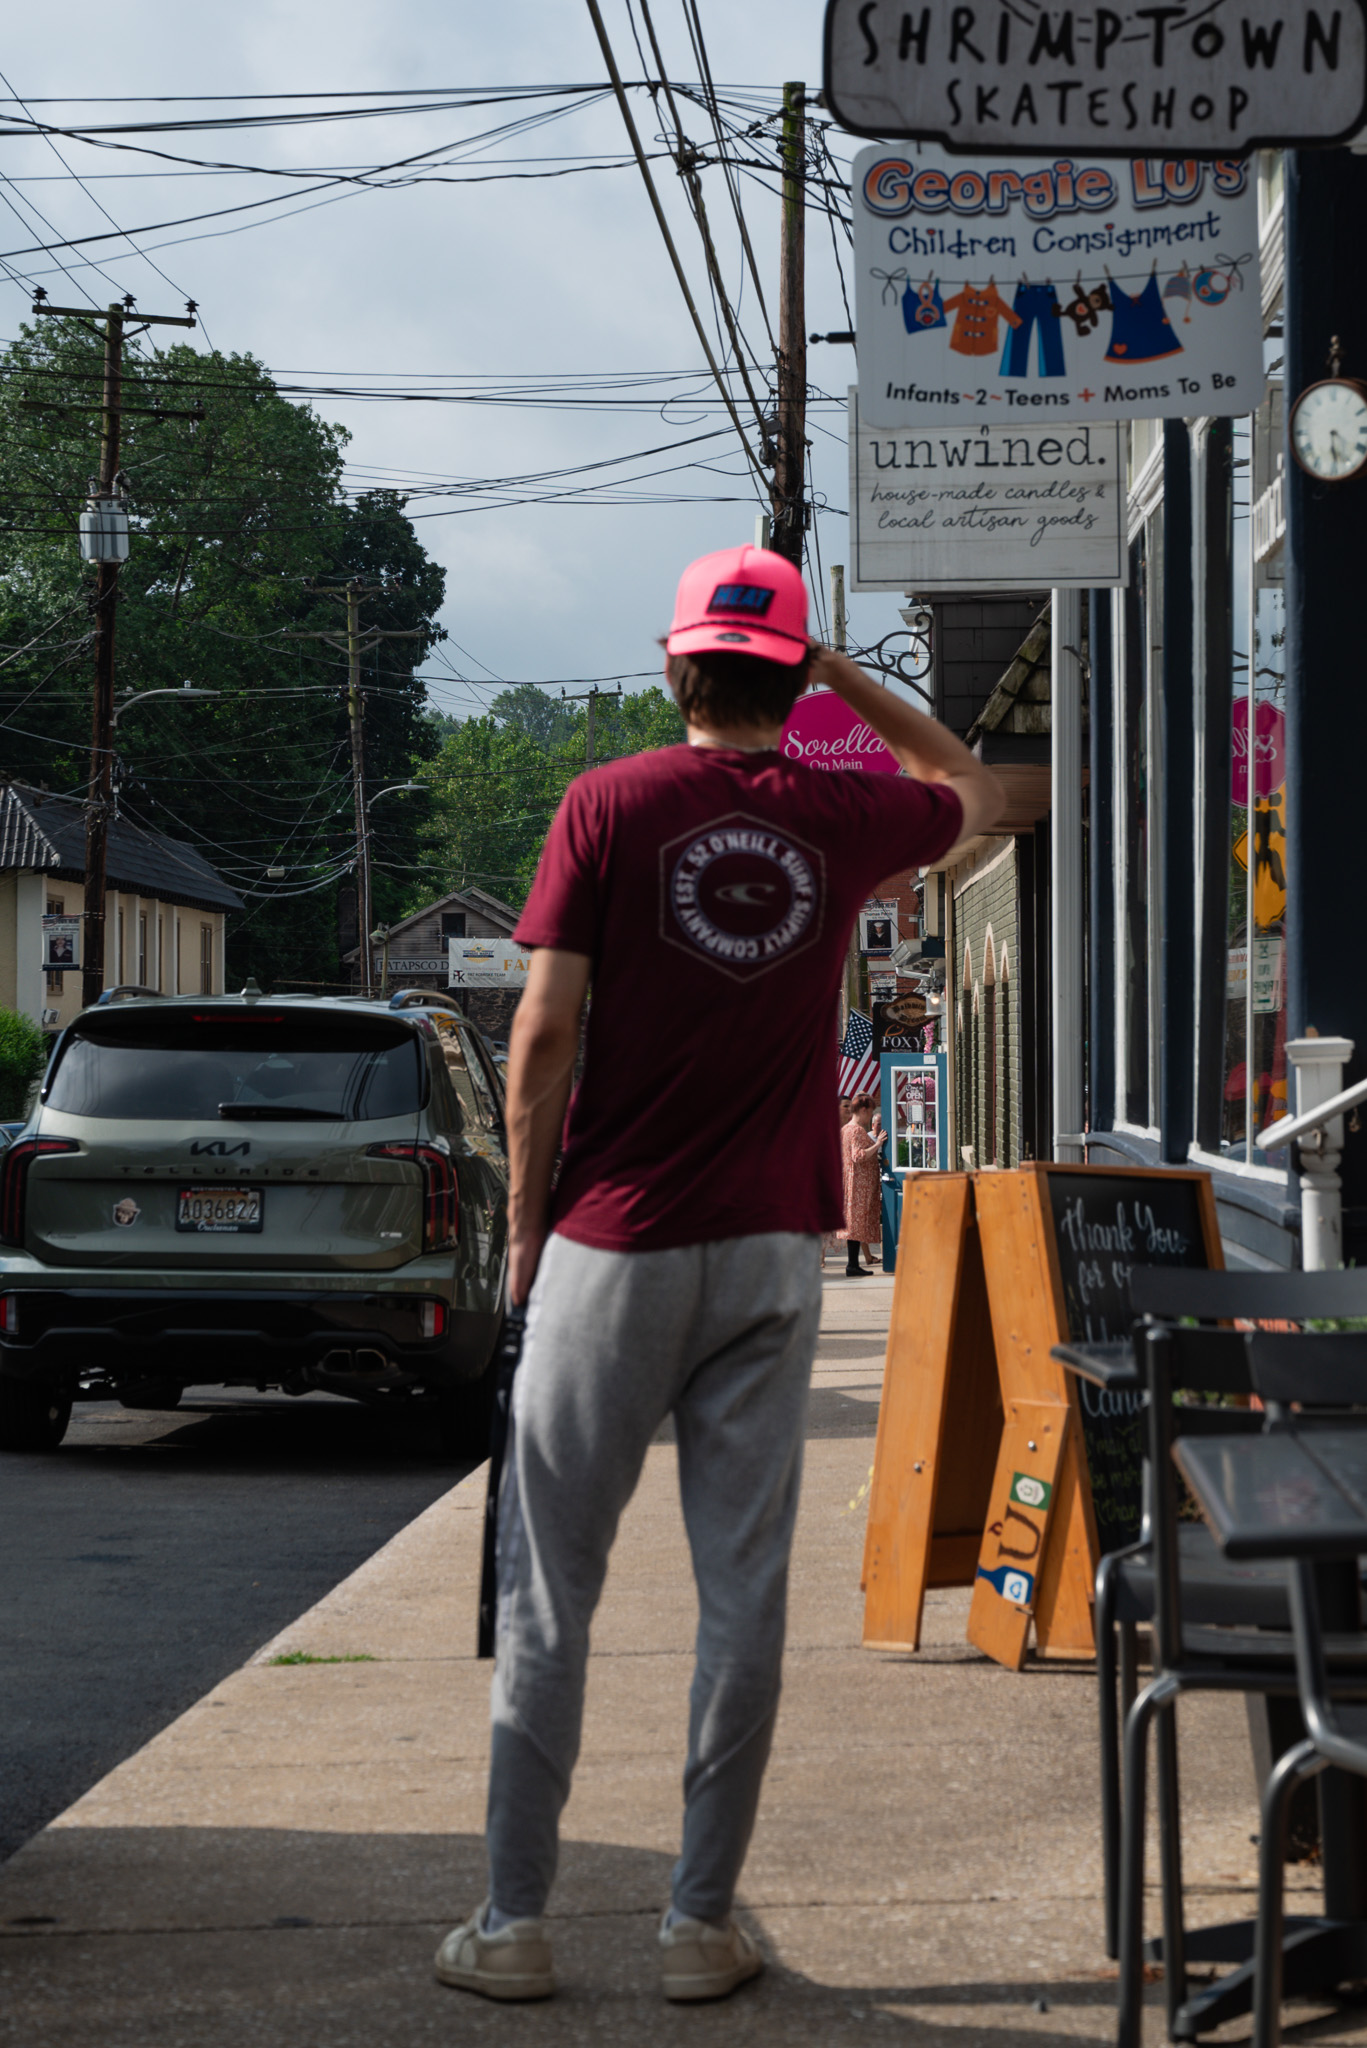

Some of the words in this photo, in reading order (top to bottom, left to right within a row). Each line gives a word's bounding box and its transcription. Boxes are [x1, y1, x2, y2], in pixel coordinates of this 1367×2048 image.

[946, 79, 1249, 131] SKATESHOP
[863, 158, 1116, 217] Georgie
[888, 226, 1016, 259] Children
[1033, 210, 1222, 257] Consignment
[1104, 382, 1171, 404] Moms
[1178, 377, 1201, 396] To
[1212, 373, 1237, 391] Be
[870, 481, 999, 506] house-made
[1004, 480, 1093, 503] candles
[878, 509, 936, 529] local
[941, 505, 1030, 532] artisan
[1029, 507, 1099, 548] goods
[783, 723, 888, 760] Sorella
[809, 759, 830, 771] On
[832, 758, 864, 770] Main
[779, 849, 813, 897] SURF
[679, 907, 760, 959] COMPANY
[763, 900, 811, 954] SUPPLY
[882, 1035, 922, 1048] FOXY
[190, 1141, 250, 1157] KIA
[121, 1167, 320, 1177] TELLURIDE
[1133, 1200, 1190, 1255] You
